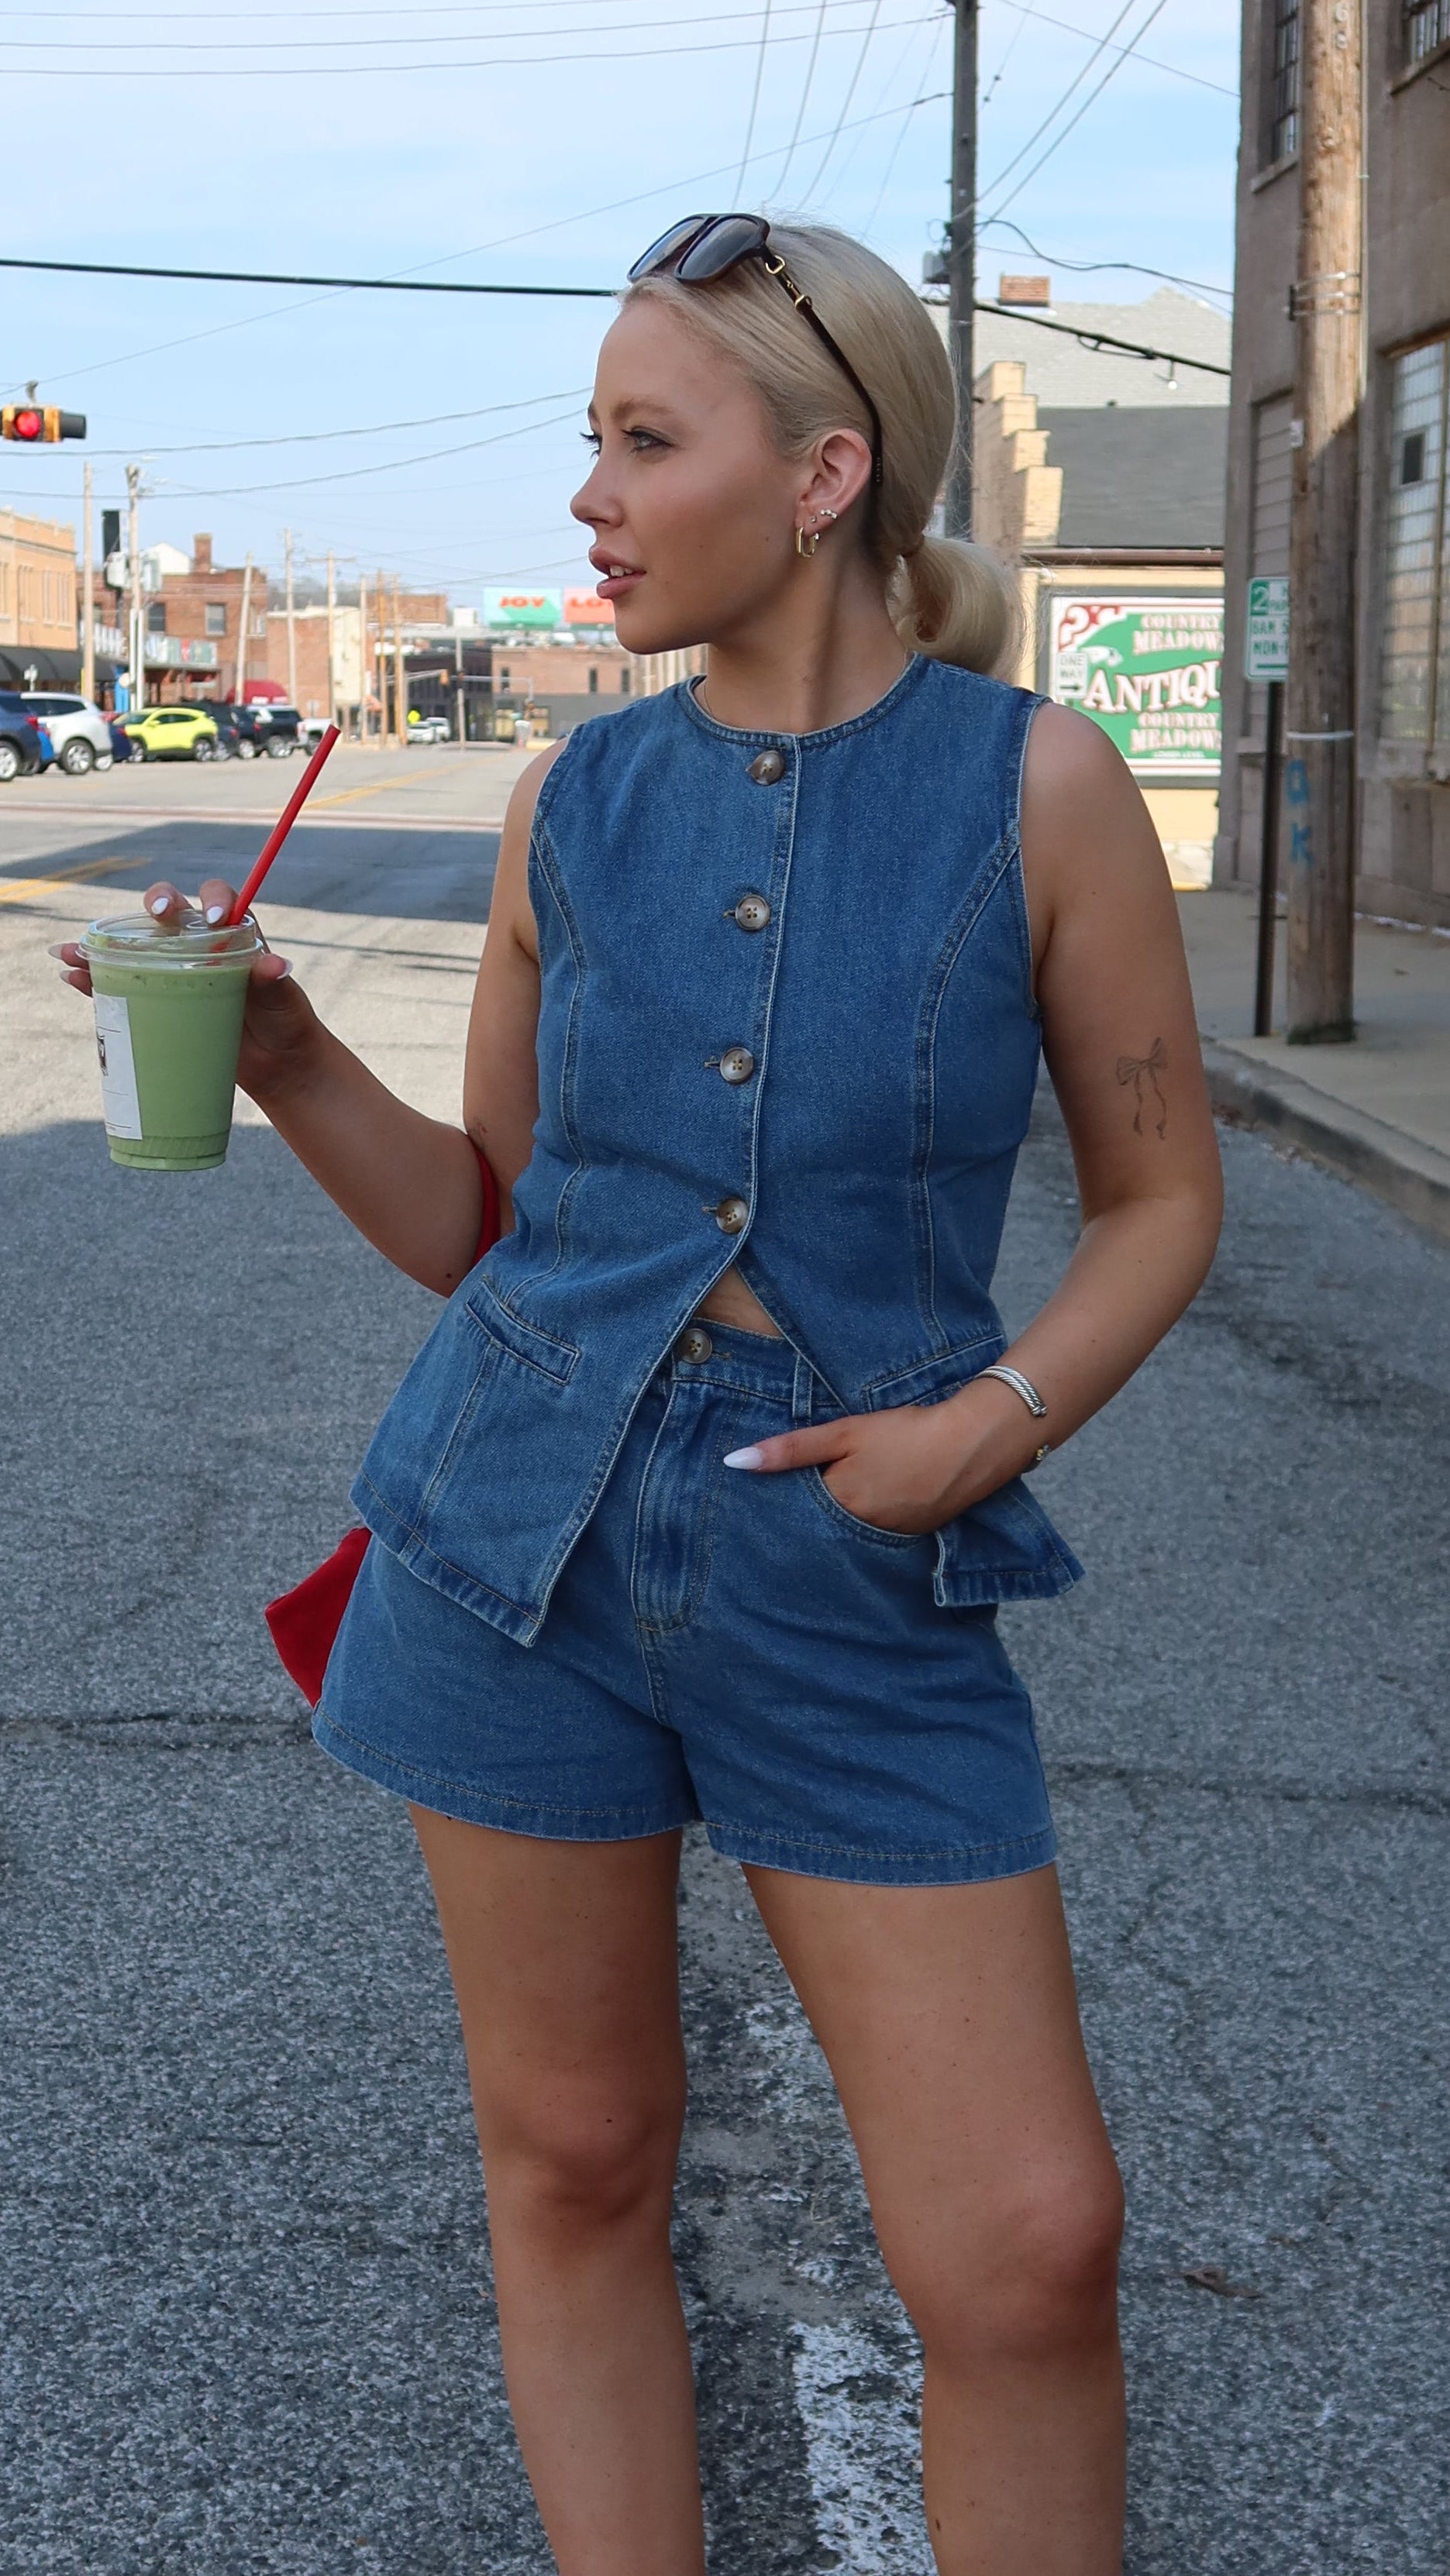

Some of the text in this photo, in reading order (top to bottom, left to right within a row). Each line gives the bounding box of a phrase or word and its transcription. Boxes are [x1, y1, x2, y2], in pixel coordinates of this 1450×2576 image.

[499, 596, 545, 608] JOY
[1253, 586, 1268, 610] 2
[1141, 614, 1221, 628] COUNTRY
[1060, 655, 1083, 665] ONE
[1138, 712, 1220, 727] COUNTRY
